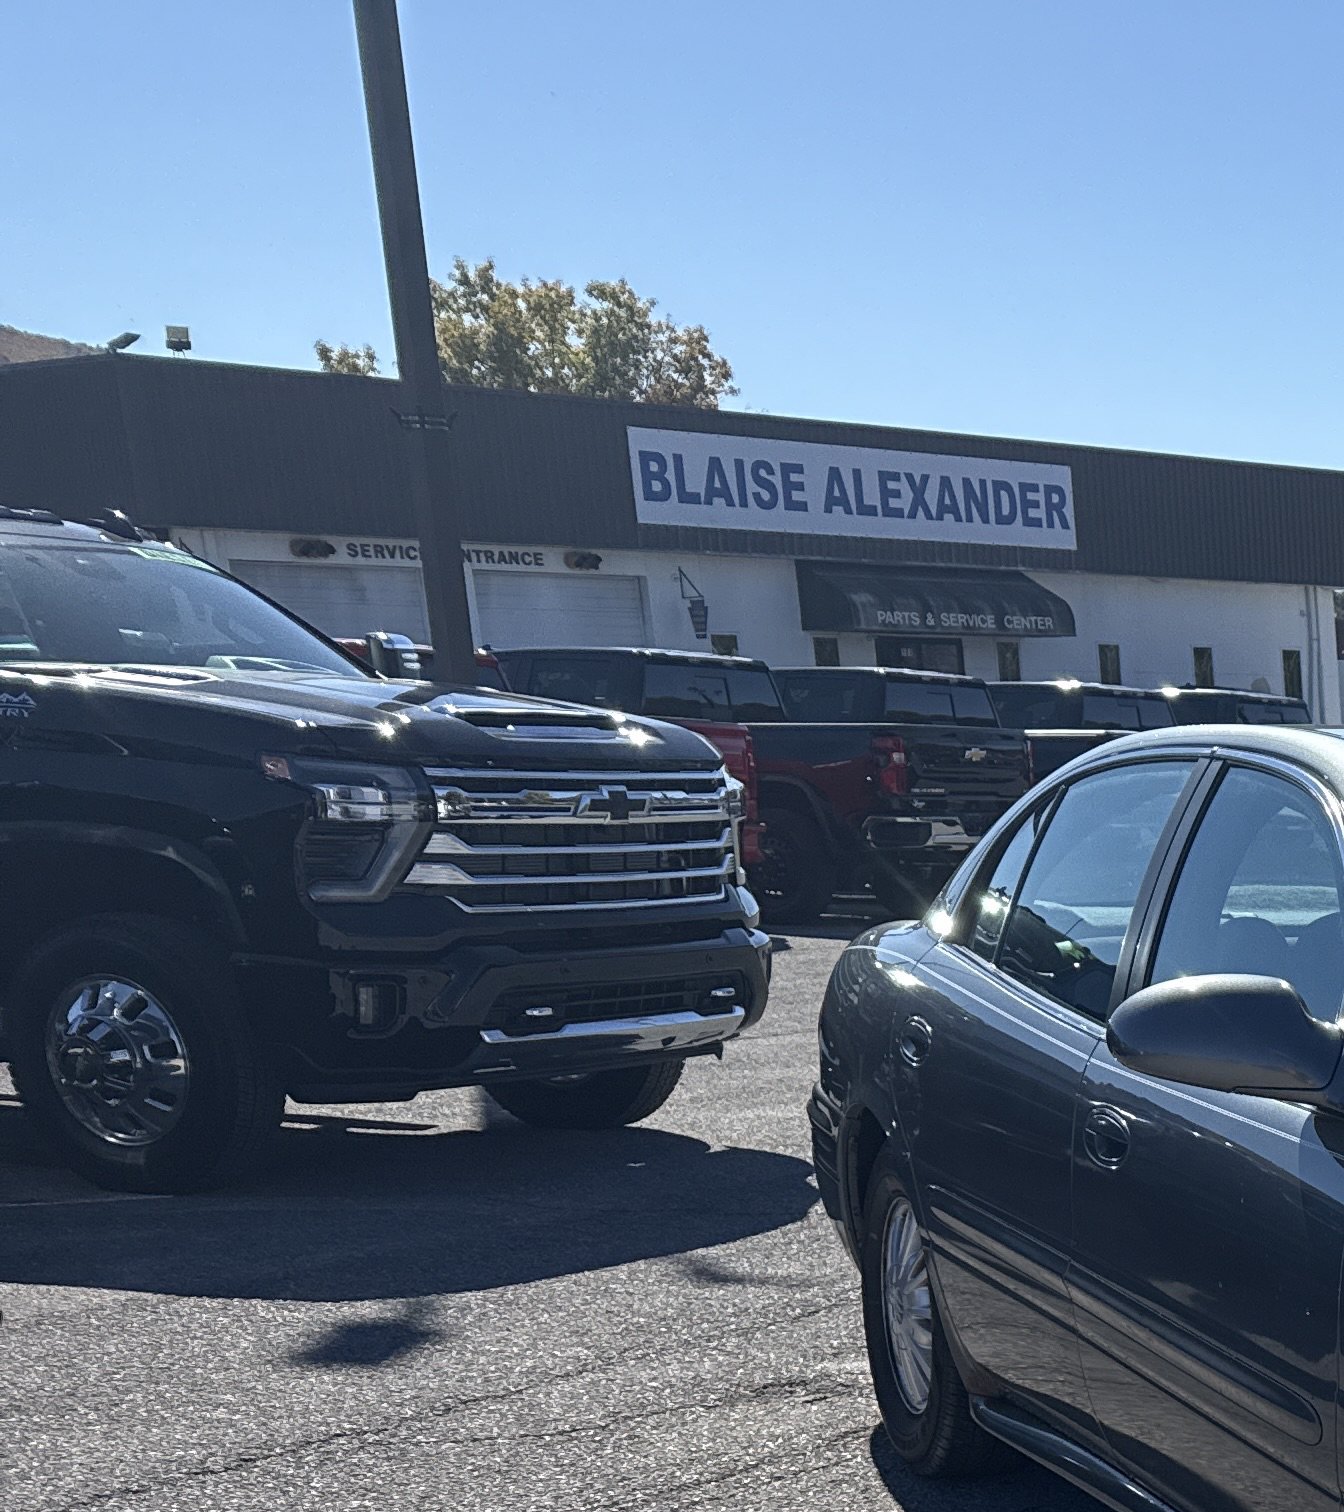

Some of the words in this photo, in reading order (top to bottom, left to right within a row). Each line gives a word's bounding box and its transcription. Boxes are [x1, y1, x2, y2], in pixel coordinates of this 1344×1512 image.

[638, 450, 809, 513] BLAISE
[823, 466, 1071, 531] ALEXANDER
[346, 542, 418, 561] SERVIC
[464, 548, 545, 567] NTRANCE
[877, 610, 920, 626] PARTS
[925, 613, 935, 626] &
[940, 613, 996, 629] SERVICE
[1003, 615, 1054, 630] CENTER
